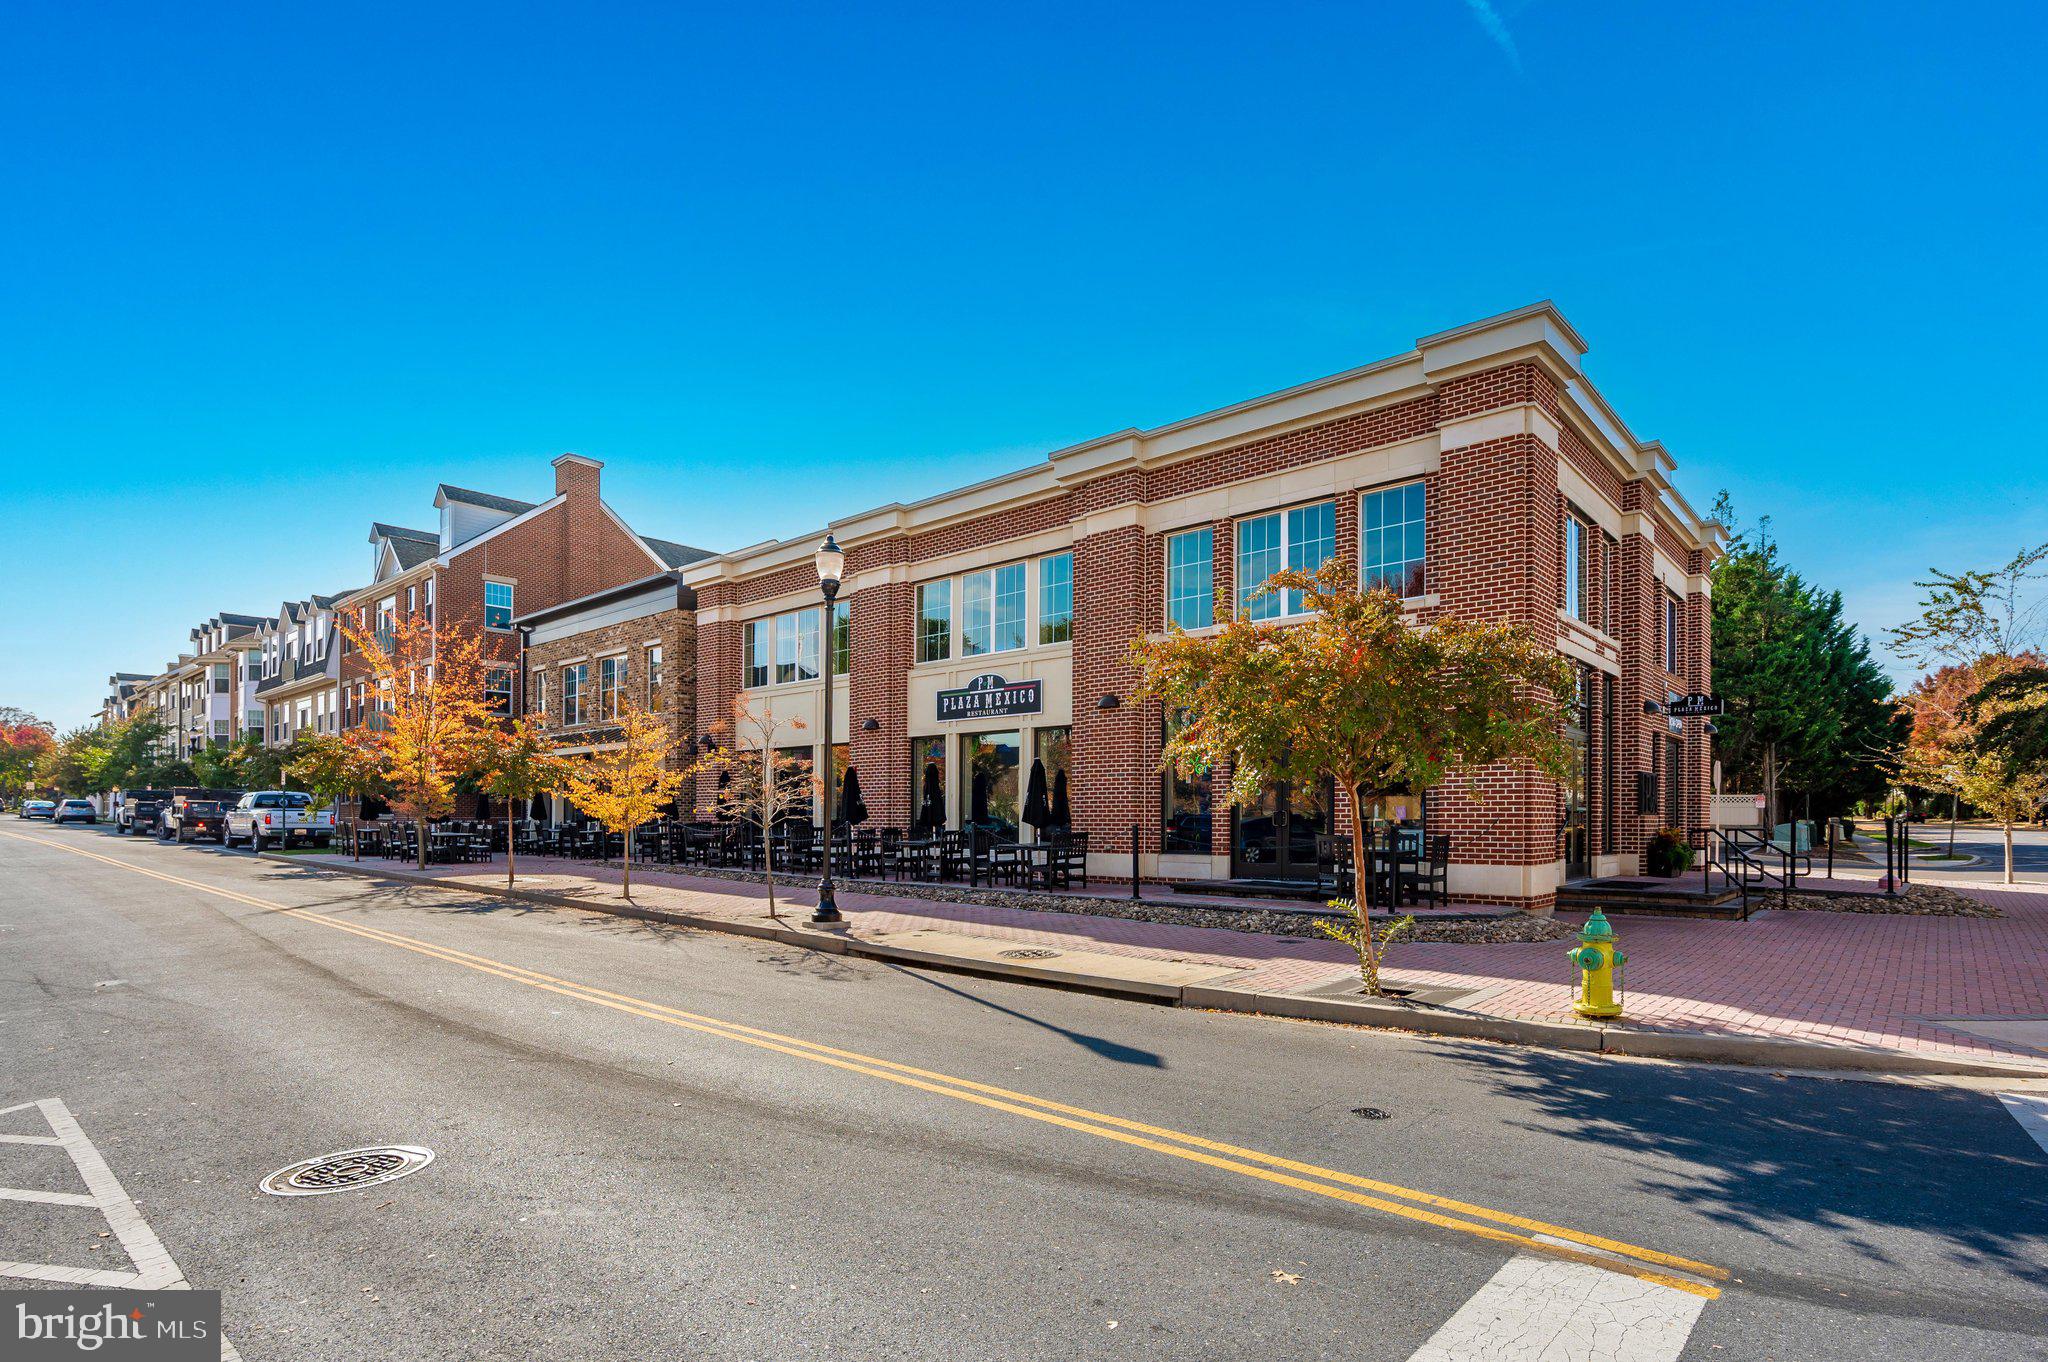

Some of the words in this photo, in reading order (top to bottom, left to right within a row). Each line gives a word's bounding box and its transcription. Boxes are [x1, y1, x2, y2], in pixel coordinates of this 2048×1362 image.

[943, 695, 979, 712] PLAZA
[985, 689, 1034, 708] MEXICO
[966, 708, 1008, 717] RESTAURANT
